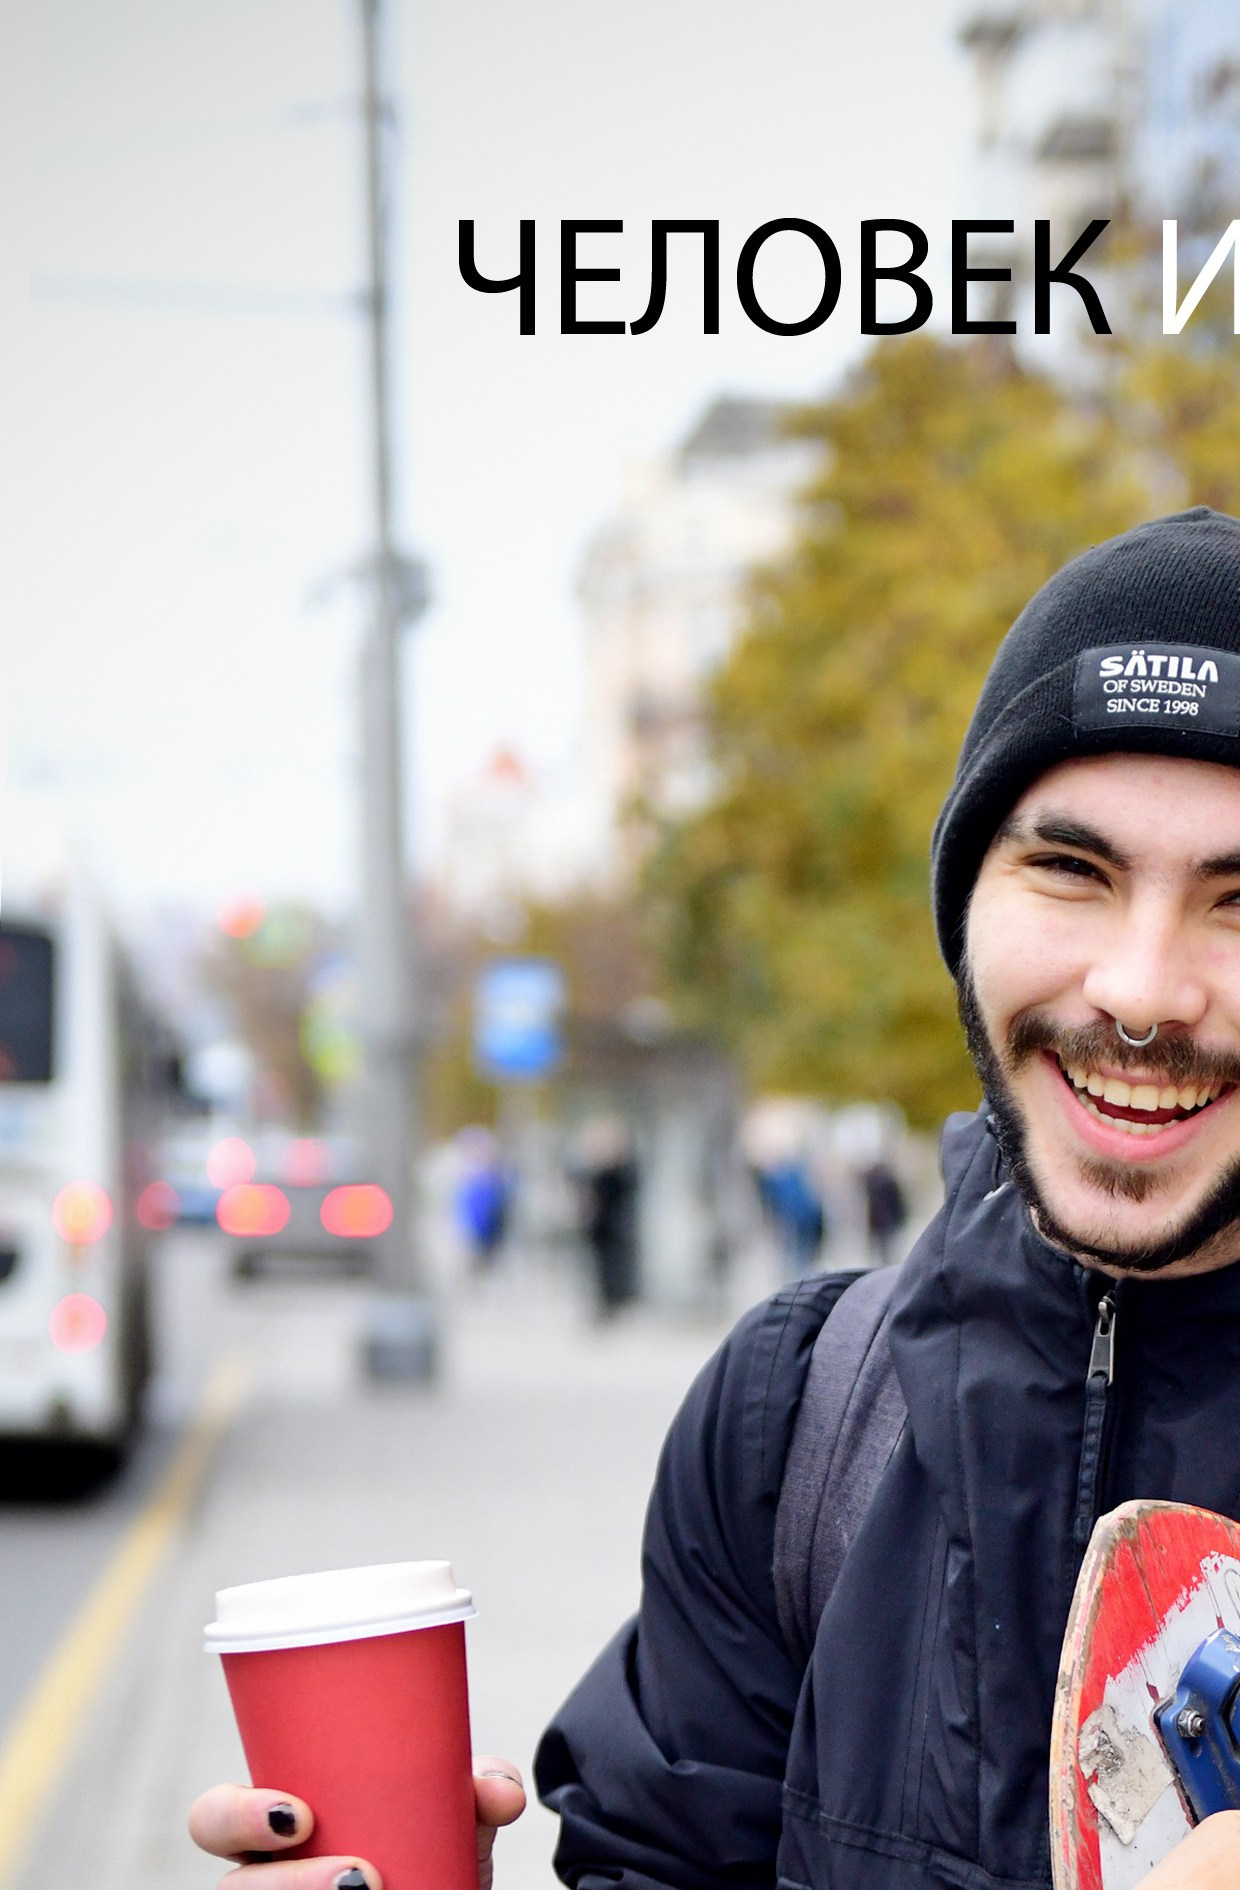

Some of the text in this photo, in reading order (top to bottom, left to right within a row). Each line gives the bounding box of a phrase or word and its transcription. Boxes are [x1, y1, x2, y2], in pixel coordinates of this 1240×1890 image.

[1099, 650, 1218, 682] SÄTILA
[1103, 679, 1206, 697] OF SWEDEN
[1107, 698, 1199, 716] SINCE 1998
